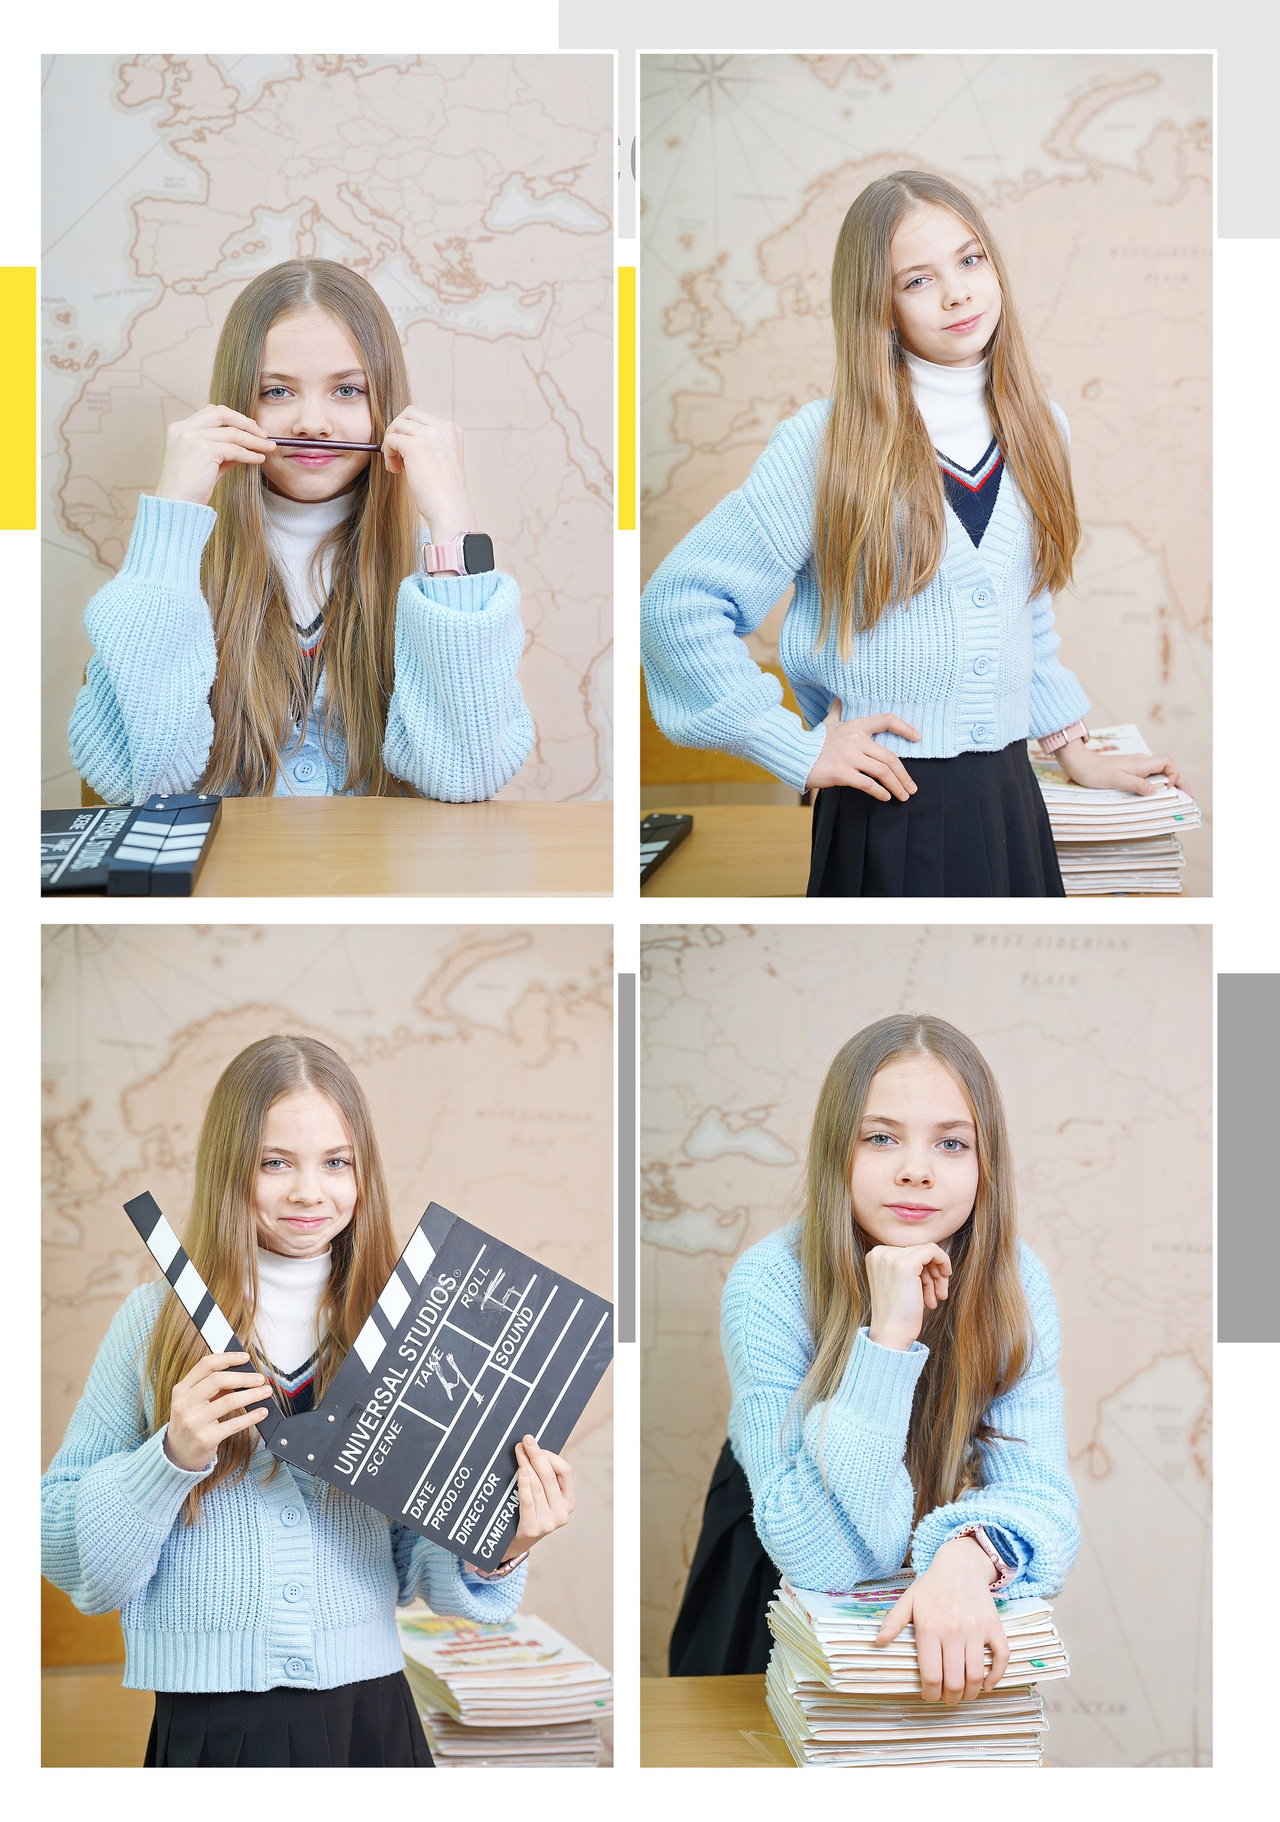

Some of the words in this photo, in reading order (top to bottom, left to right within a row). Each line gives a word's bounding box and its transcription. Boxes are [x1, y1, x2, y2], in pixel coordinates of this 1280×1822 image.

[460, 1267, 491, 1309] ROLL
[495, 1306, 534, 1366] SOUND
[414, 1345, 445, 1389] TAKE
[333, 1367, 409, 1476] UNIVERSAL
[366, 1419, 403, 1477] SCENE
[409, 1480, 437, 1520] DATE
[430, 1466, 474, 1531] PROD.CO.
[455, 1472, 501, 1546] DIRECTOR
[480, 1487, 520, 1559] CAMERAM
